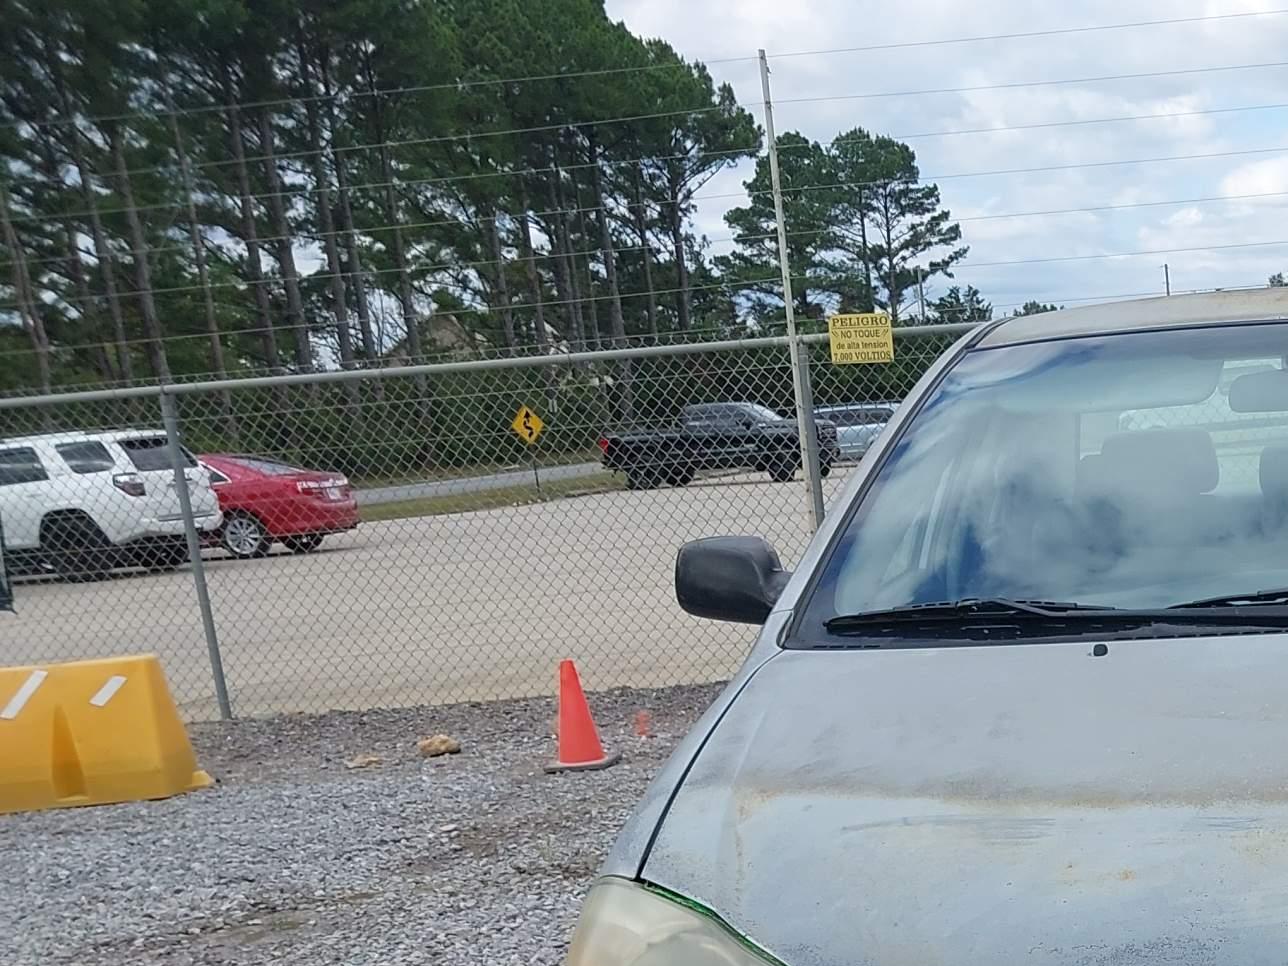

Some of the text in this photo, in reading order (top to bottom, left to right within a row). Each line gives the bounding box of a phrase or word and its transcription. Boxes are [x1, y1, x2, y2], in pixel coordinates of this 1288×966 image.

[832, 316, 888, 326] PELIGRO
[840, 329, 881, 339] NO TOQUE
[836, 341, 888, 350] de alta tension
[833, 350, 891, 361] 7,000 VOLTIOS
